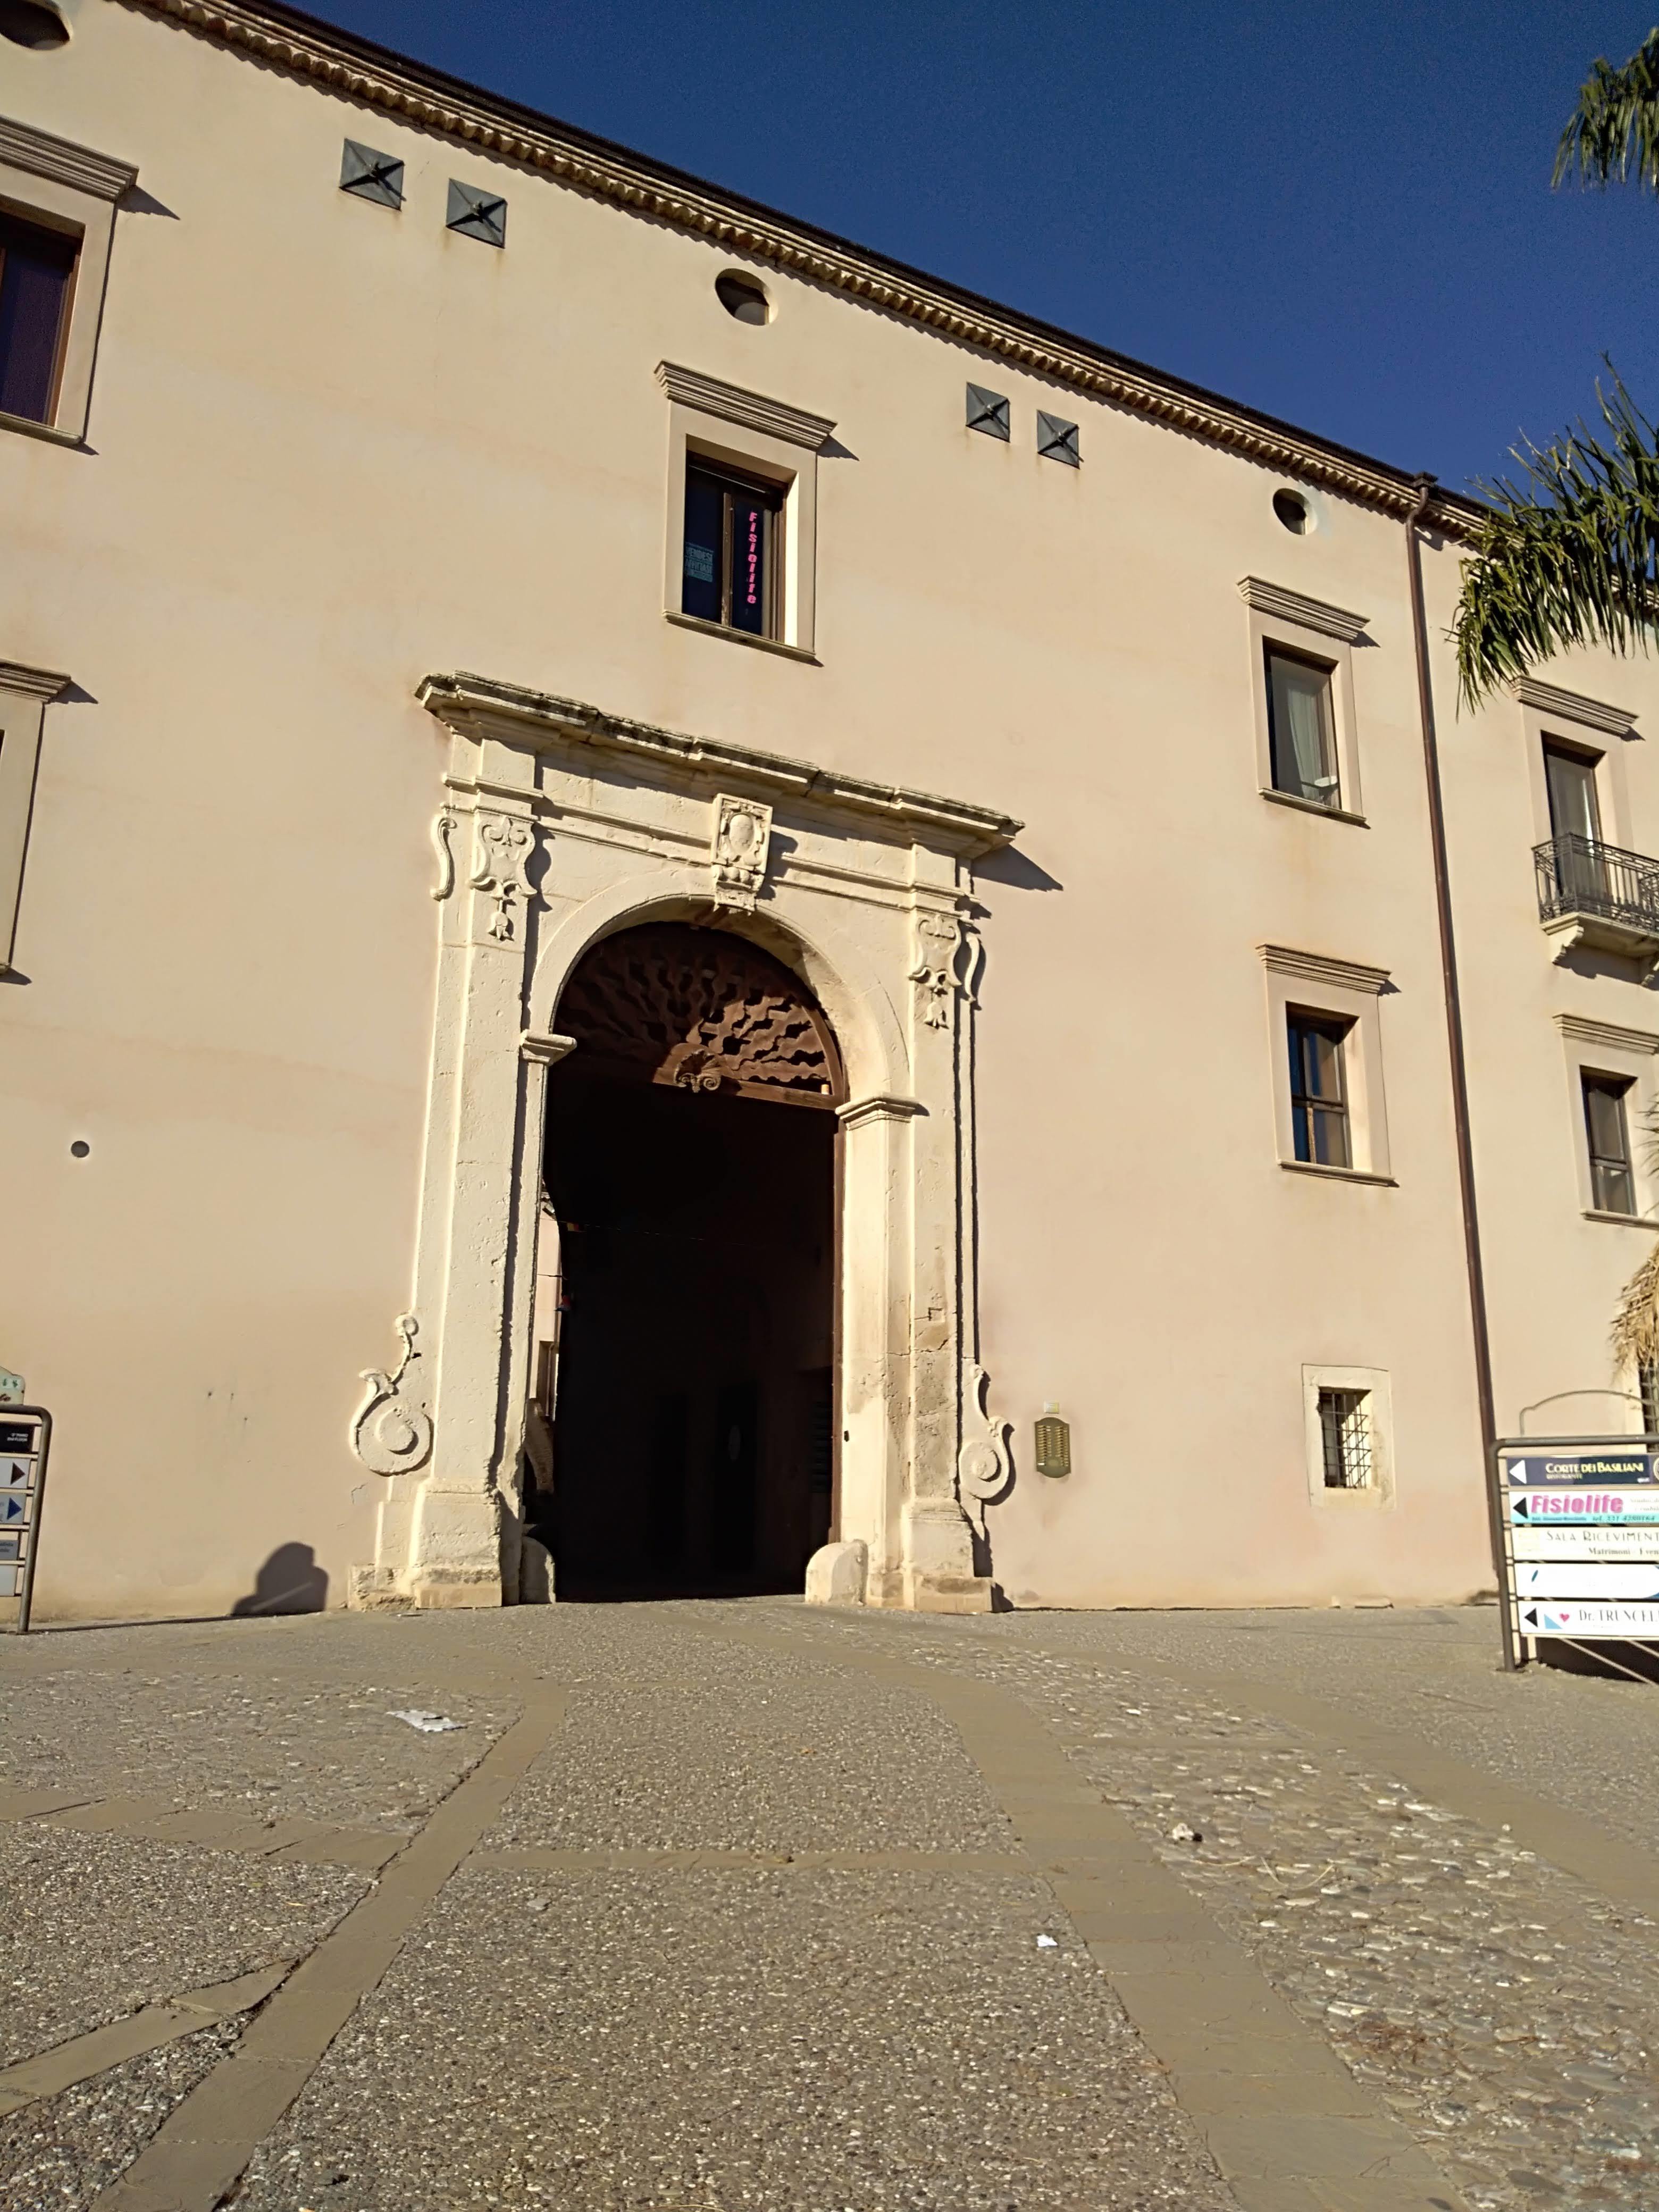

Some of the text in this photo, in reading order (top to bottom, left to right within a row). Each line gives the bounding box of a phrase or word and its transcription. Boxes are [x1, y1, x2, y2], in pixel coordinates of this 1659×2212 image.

[747, 512, 757, 604] Fisiolife
[1546, 1462, 1644, 1473] CORTE DEI BASILIANI
[1531, 1495, 1623, 1513] Fisiolife
[1547, 1530, 1576, 1541] SALA
[1579, 1610, 1659, 1622] Dr. TRUNCEL
